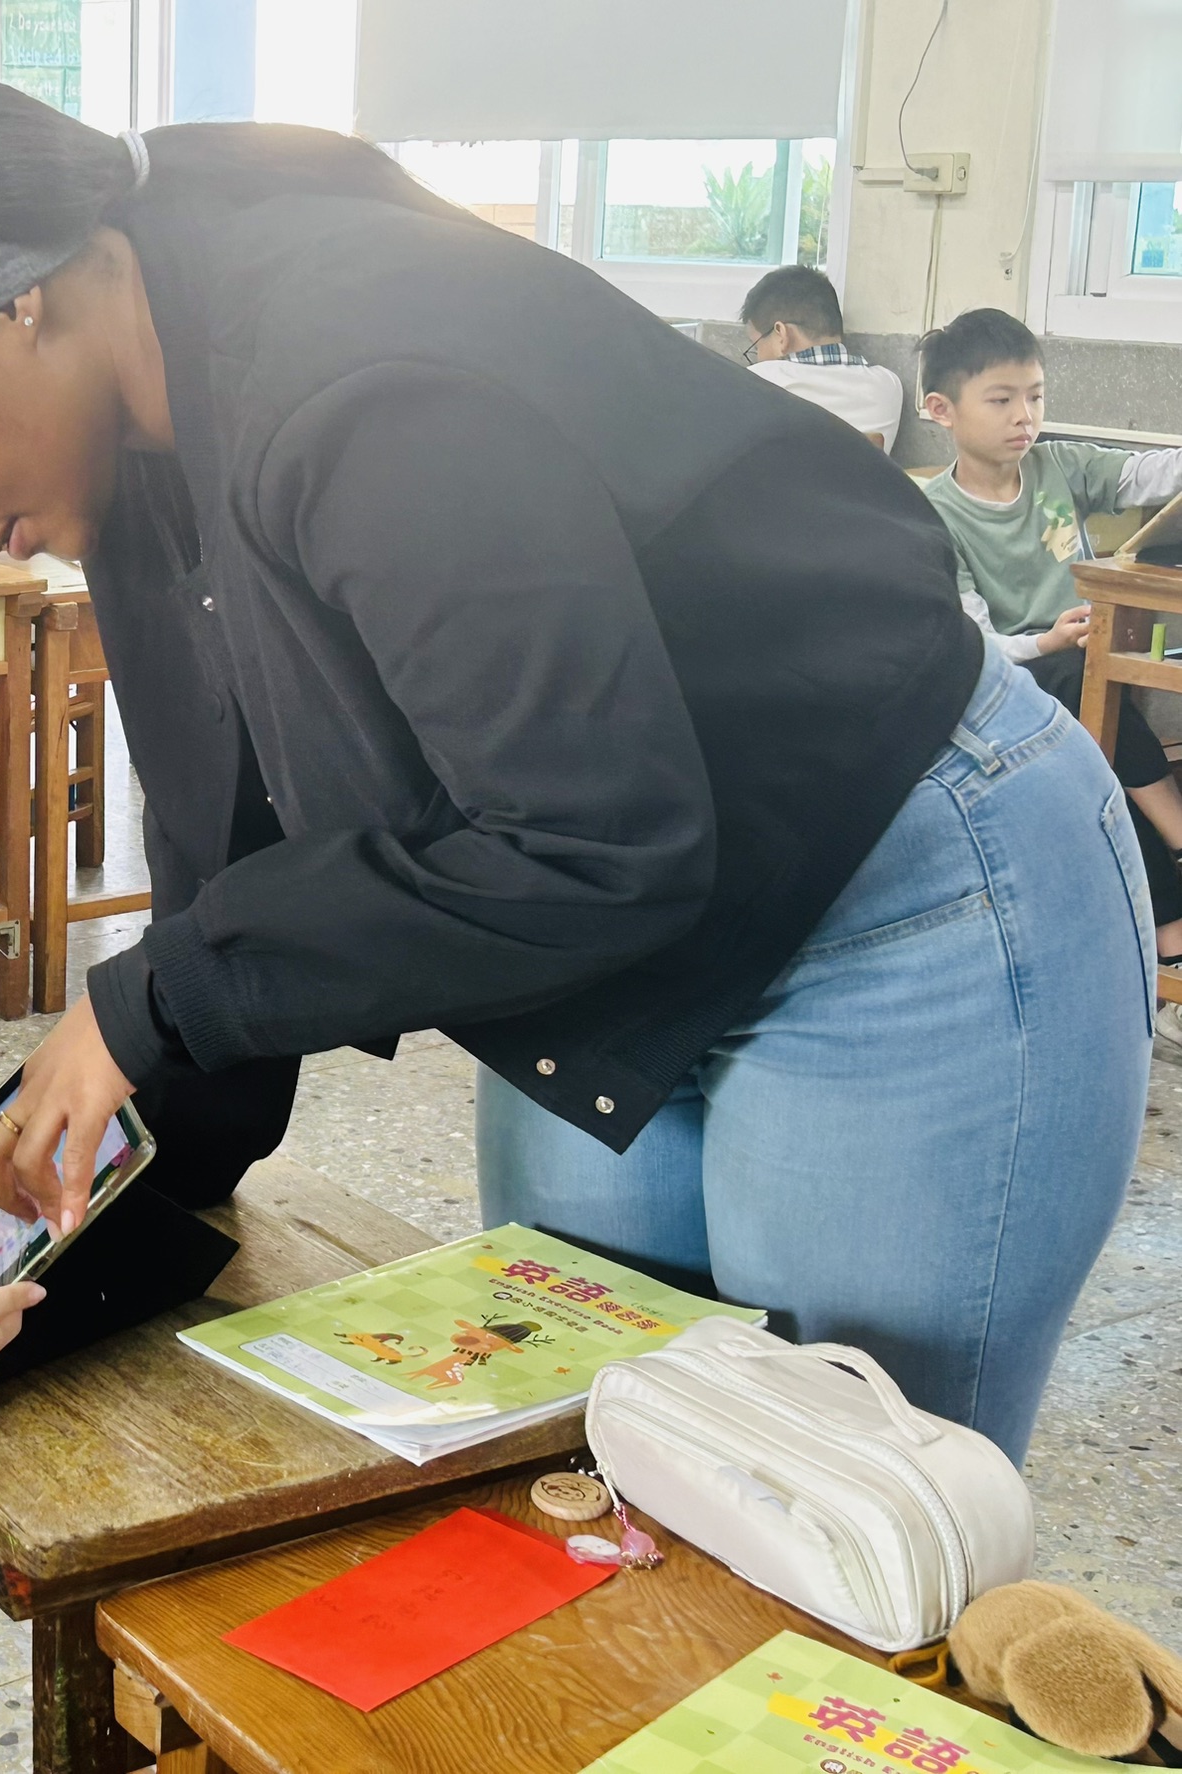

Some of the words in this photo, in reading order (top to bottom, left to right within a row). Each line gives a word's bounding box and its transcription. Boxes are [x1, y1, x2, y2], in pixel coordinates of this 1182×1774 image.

[488, 1278, 536, 1298] English
[501, 1258, 614, 1304] 英語
[803, 1733, 877, 1768] English
[808, 1696, 970, 1774] 英語
